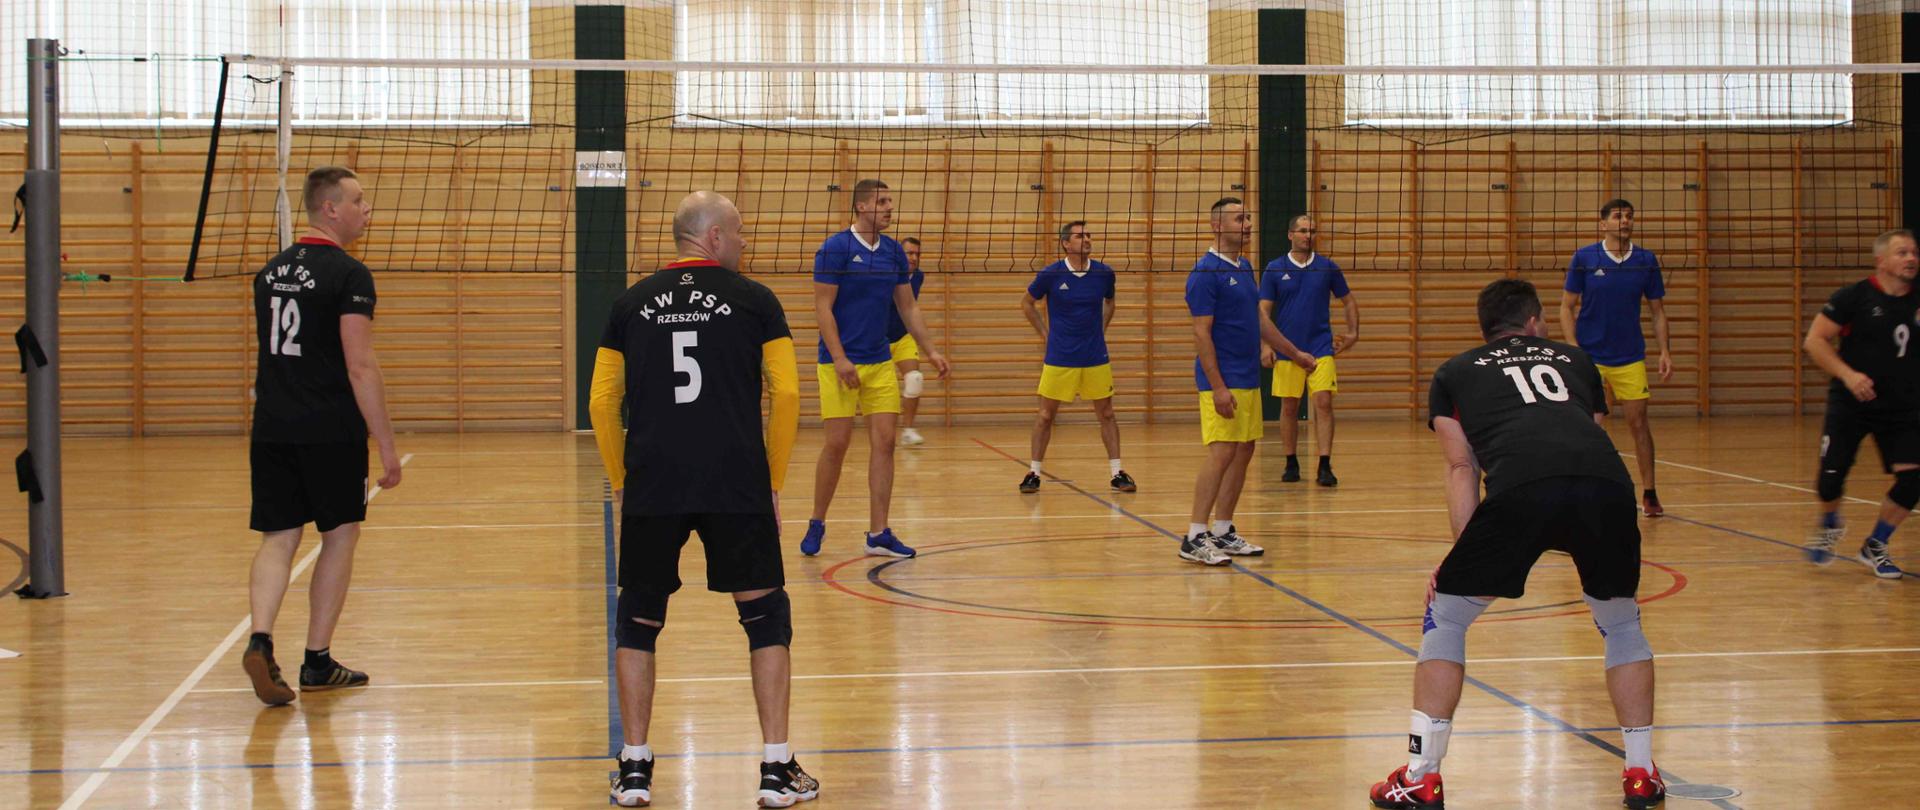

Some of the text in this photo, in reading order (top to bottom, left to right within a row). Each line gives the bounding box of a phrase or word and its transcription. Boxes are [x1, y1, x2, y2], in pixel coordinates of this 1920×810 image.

[265, 264, 316, 290] KW PSP
[639, 290, 732, 320] KW PSP
[657, 310, 711, 324] RZESZÓW
[270, 296, 302, 357] 12
[1893, 323, 1910, 358] 9
[672, 330, 703, 404] 5
[1474, 346, 1572, 366] KW PSP
[1496, 355, 1553, 365] RZESZÓW
[1502, 364, 1570, 404] 10
